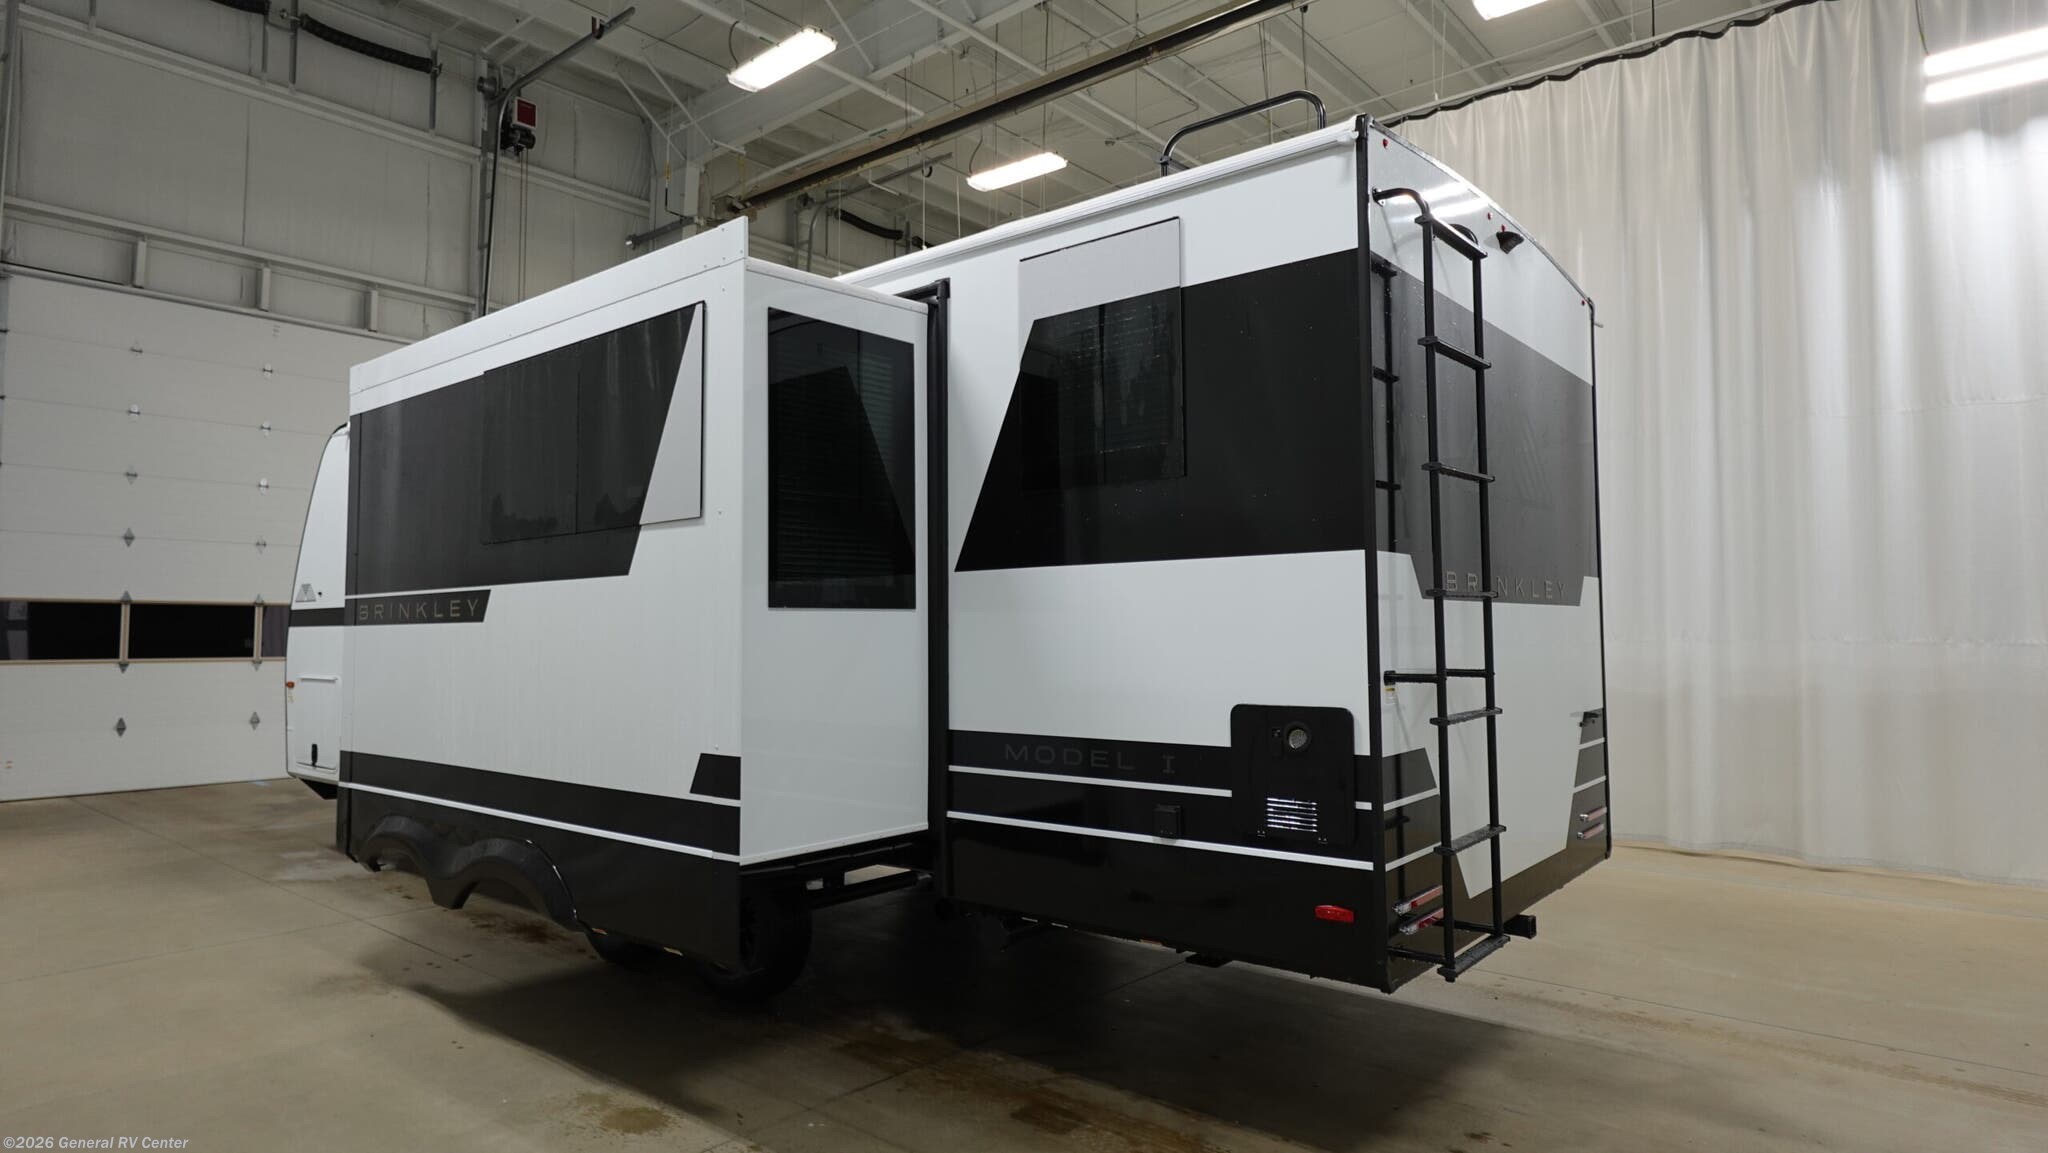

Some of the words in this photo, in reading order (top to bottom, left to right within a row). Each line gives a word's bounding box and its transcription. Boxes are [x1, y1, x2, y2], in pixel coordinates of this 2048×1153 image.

[1446, 571, 1567, 599] BRNKLEY
[359, 600, 479, 620] BRINKLEY
[1004, 744, 1136, 771] MODEL
[1162, 753, 1176, 774] I
